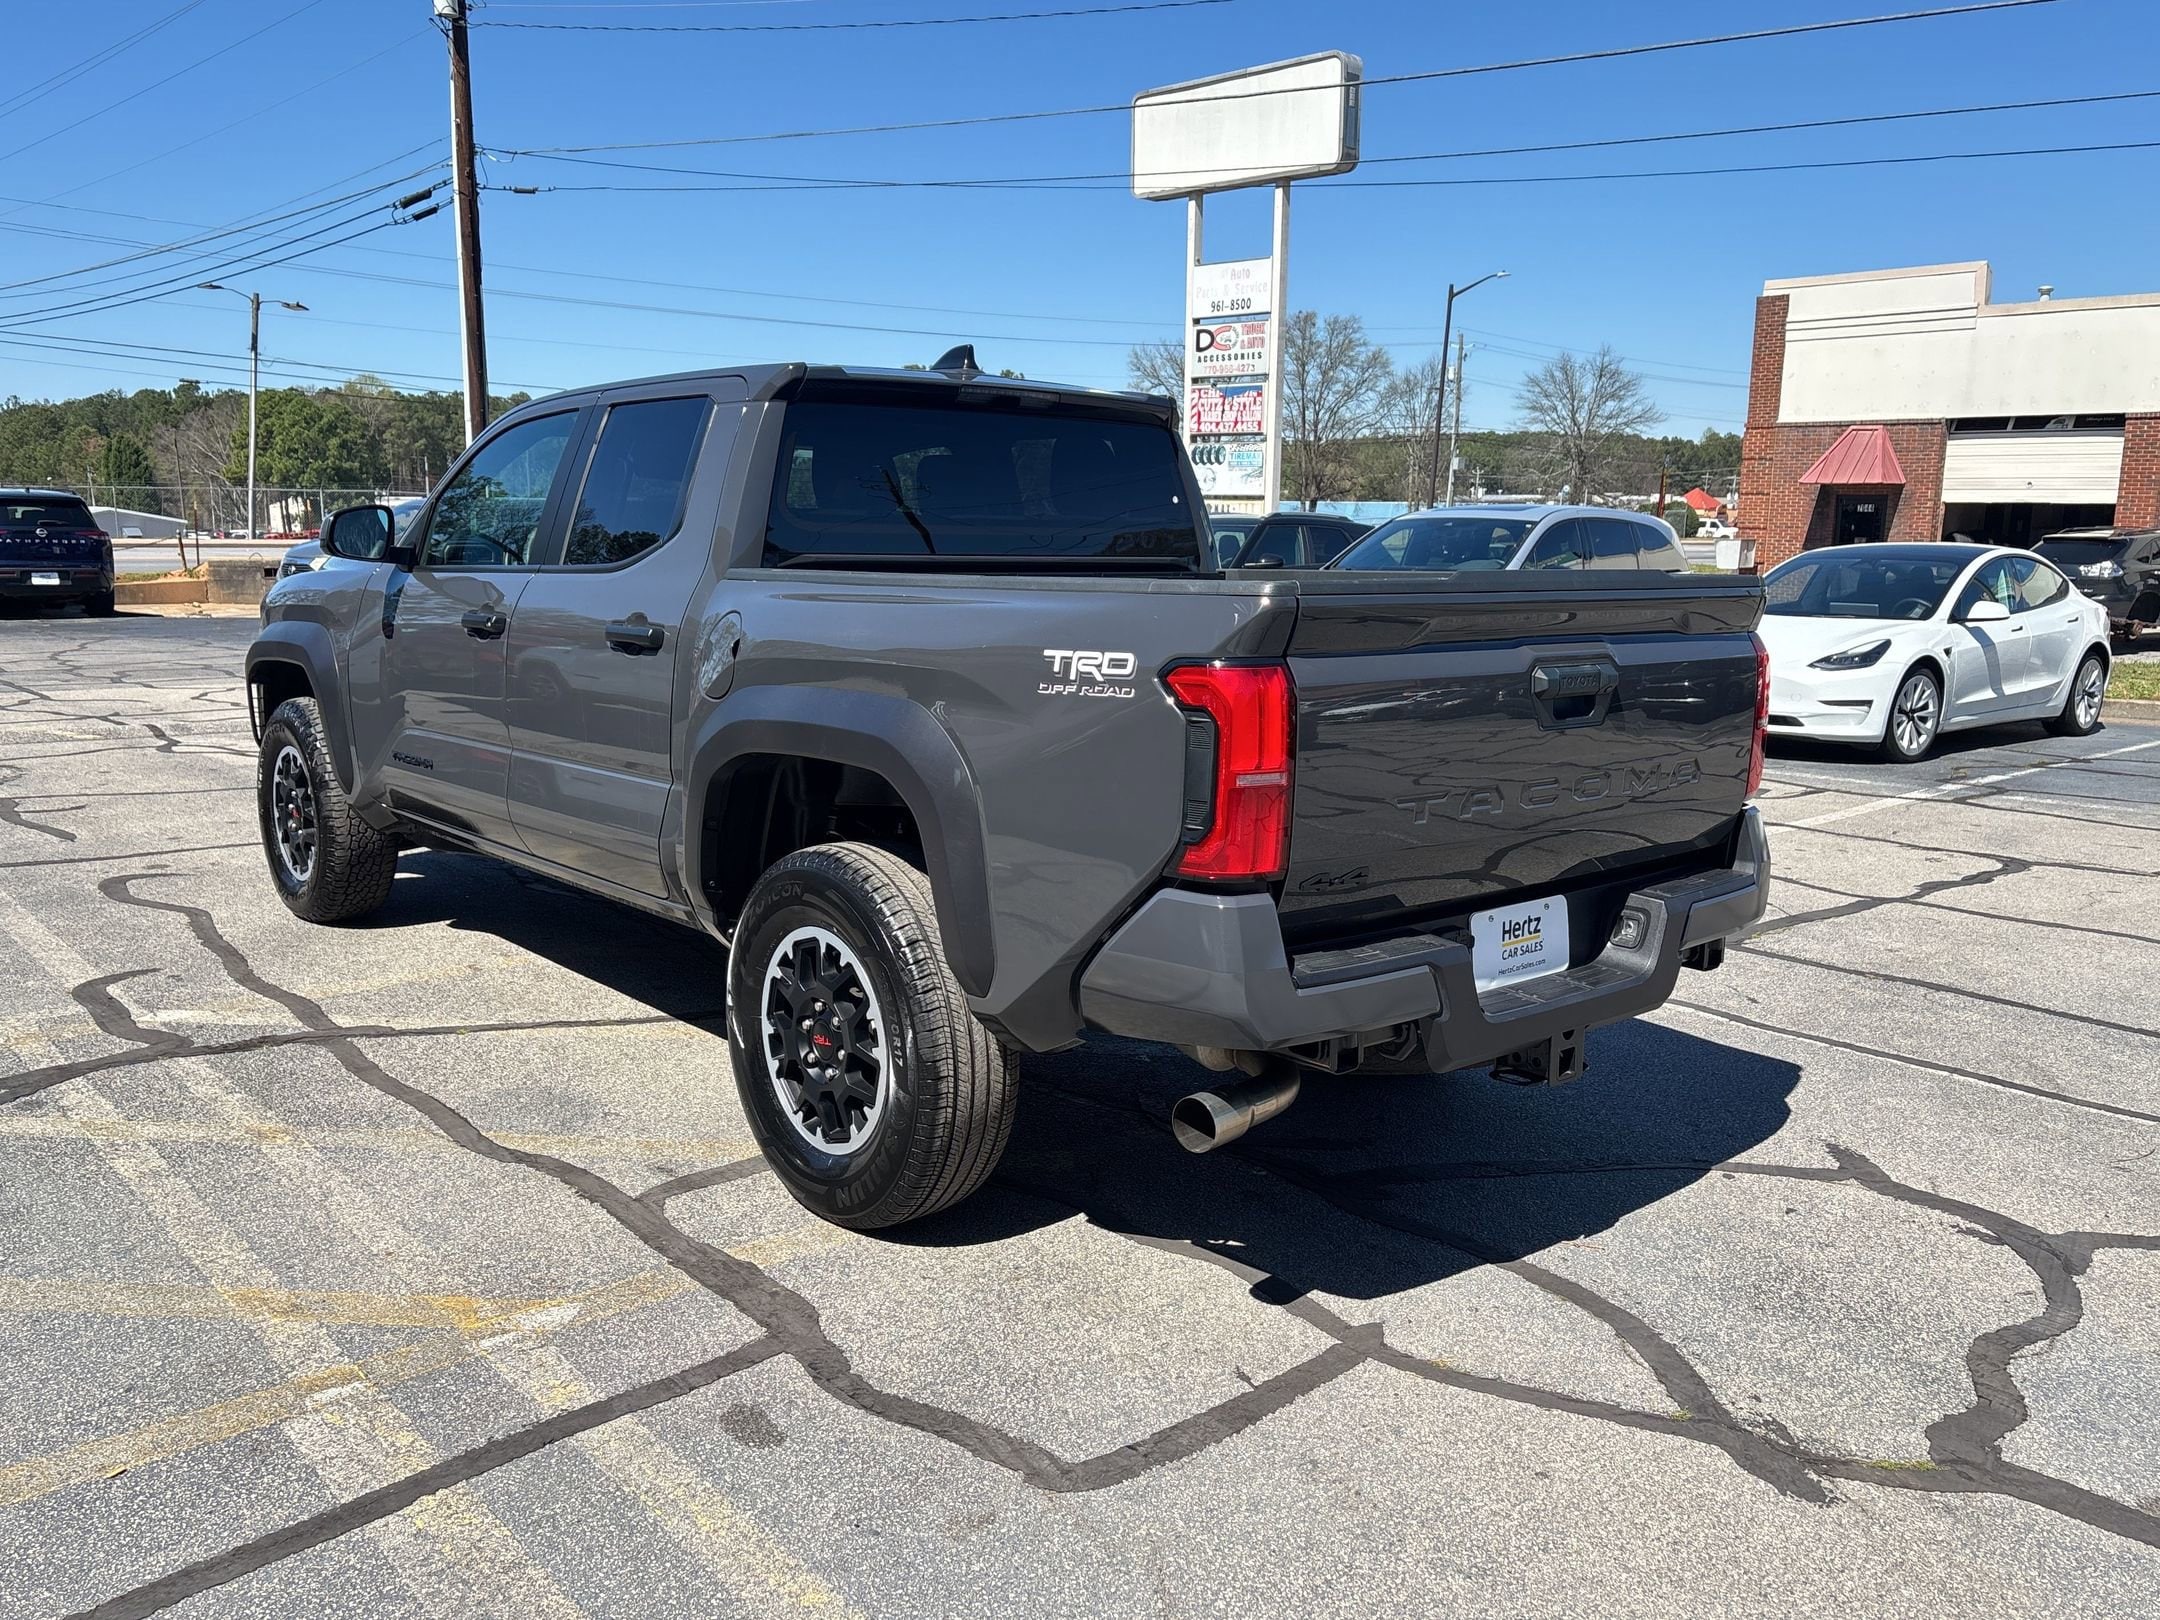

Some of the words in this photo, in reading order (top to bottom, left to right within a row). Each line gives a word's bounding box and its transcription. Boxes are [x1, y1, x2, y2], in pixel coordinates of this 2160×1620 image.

[1210, 297, 1252, 313] 961-8500
[1197, 352, 1263, 363] ACCESSORIES
[1043, 649, 1137, 682] TRD
[1561, 674, 1598, 688] TOYOTA
[1079, 686, 1135, 698] ROAD
[1396, 757, 1700, 824] TACOMA
[1501, 915, 1542, 942] Hertz
[1501, 946, 1519, 960] CAR
[1519, 940, 1544, 956] SALES
[1497, 958, 1546, 976] HertzCarSales.com
